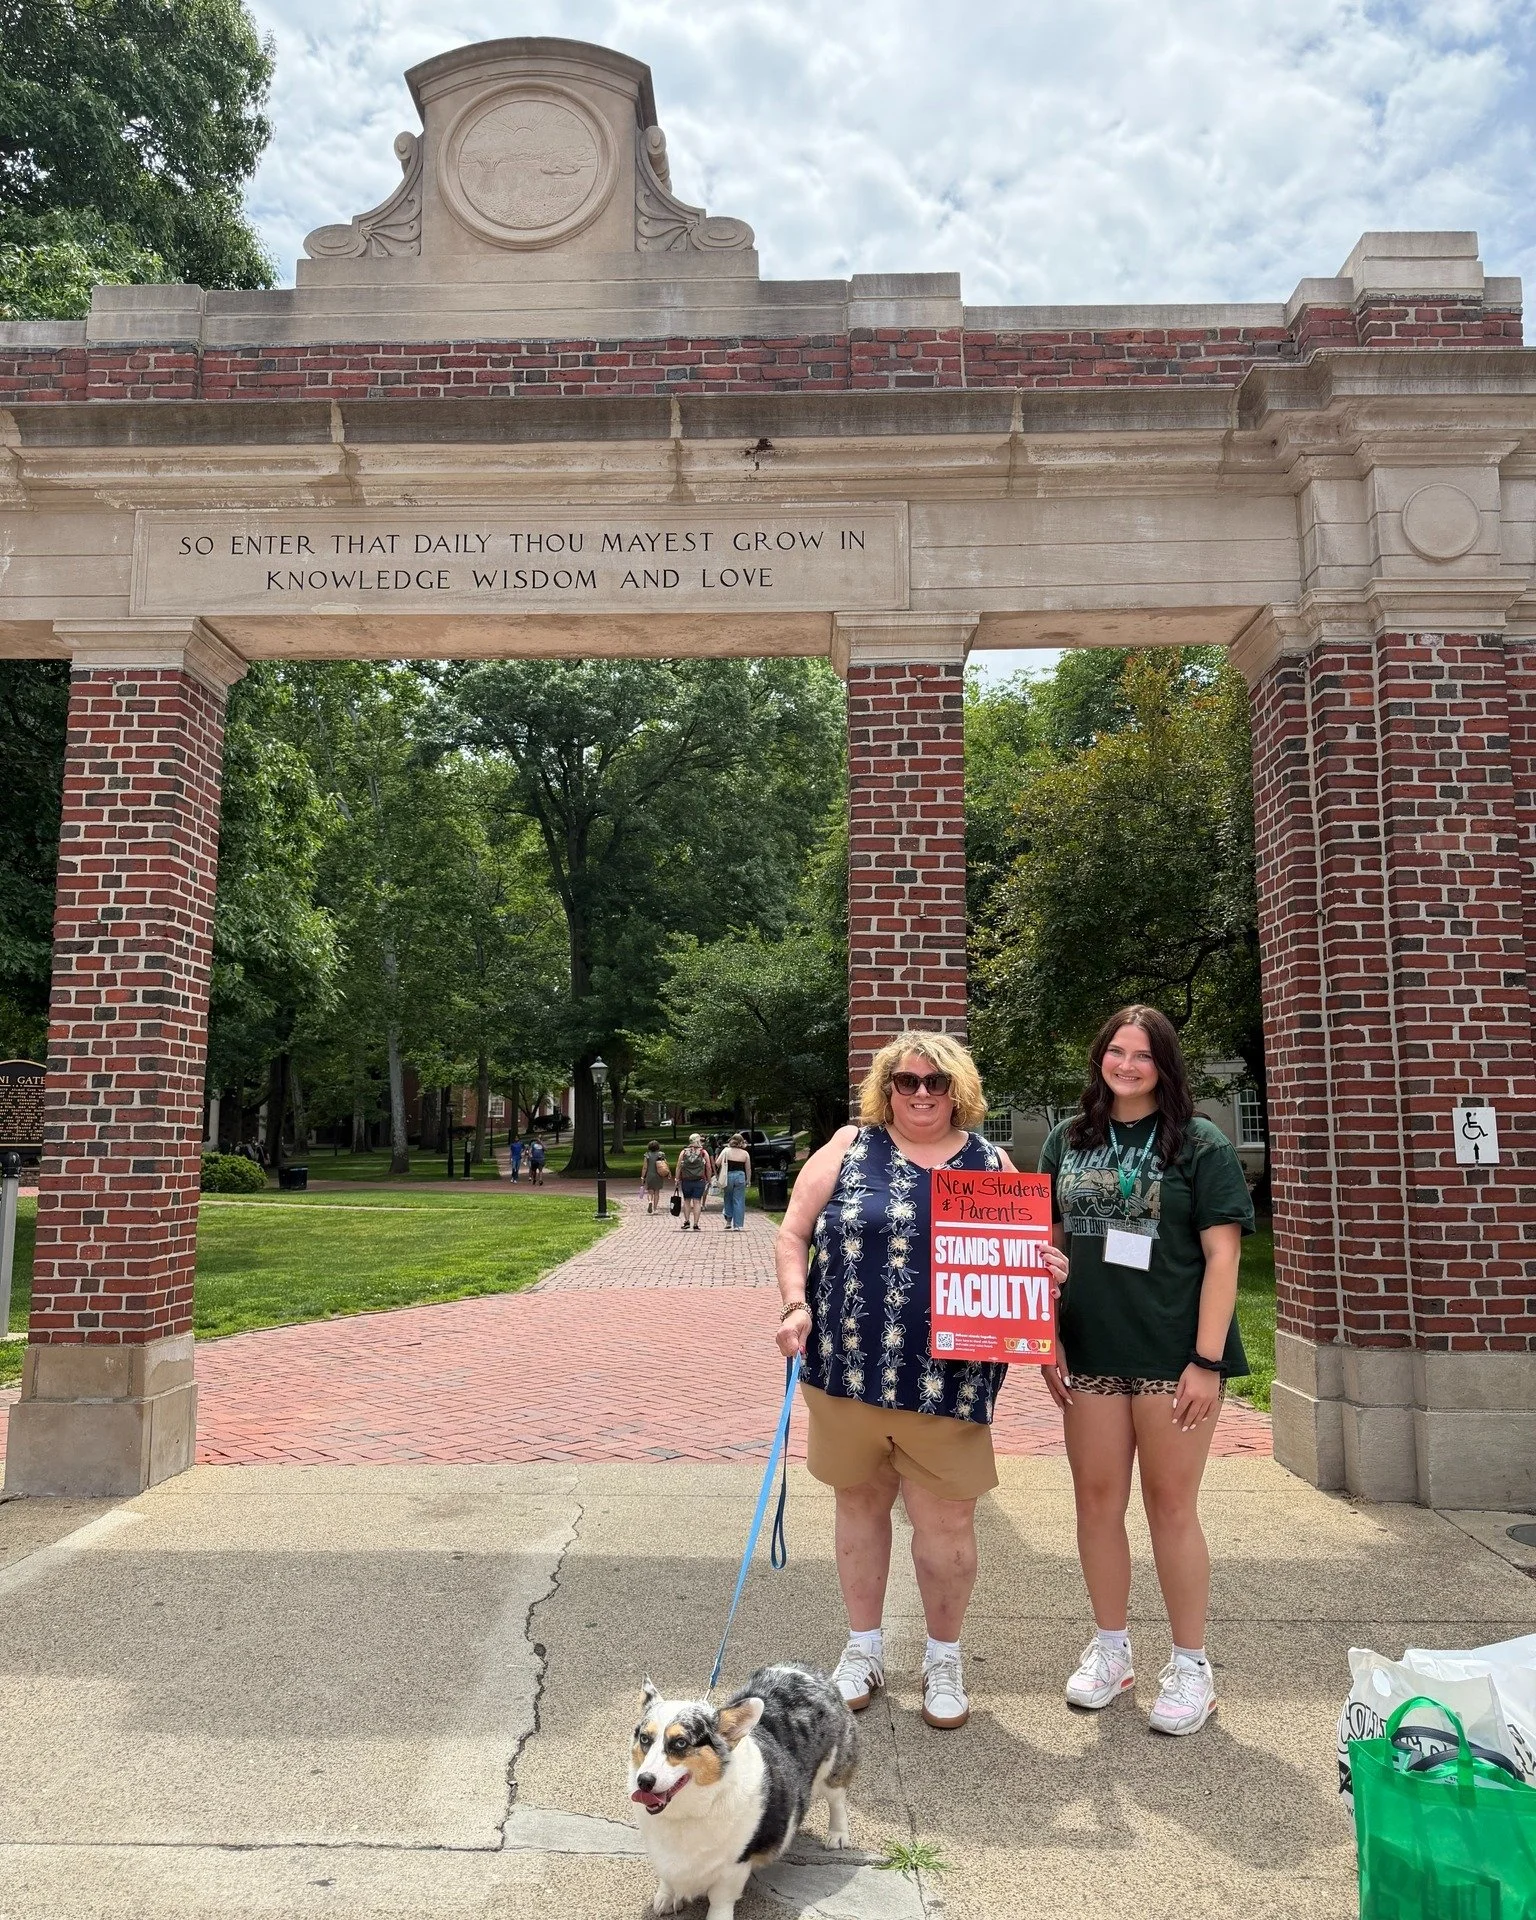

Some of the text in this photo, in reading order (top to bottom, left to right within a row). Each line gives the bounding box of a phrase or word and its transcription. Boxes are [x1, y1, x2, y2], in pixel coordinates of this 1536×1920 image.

[178, 530, 866, 556] SO ENTER THAT DAILY THOU MAYEST GROW IN
[266, 567, 774, 591] KNOWLEDGE WISDOM AND LOVE
[936, 1172, 1050, 1198] New Students
[955, 1195, 1033, 1222] Parents
[935, 1235, 1000, 1267] STANDS
[935, 1272, 1051, 1321] FACULTY!
